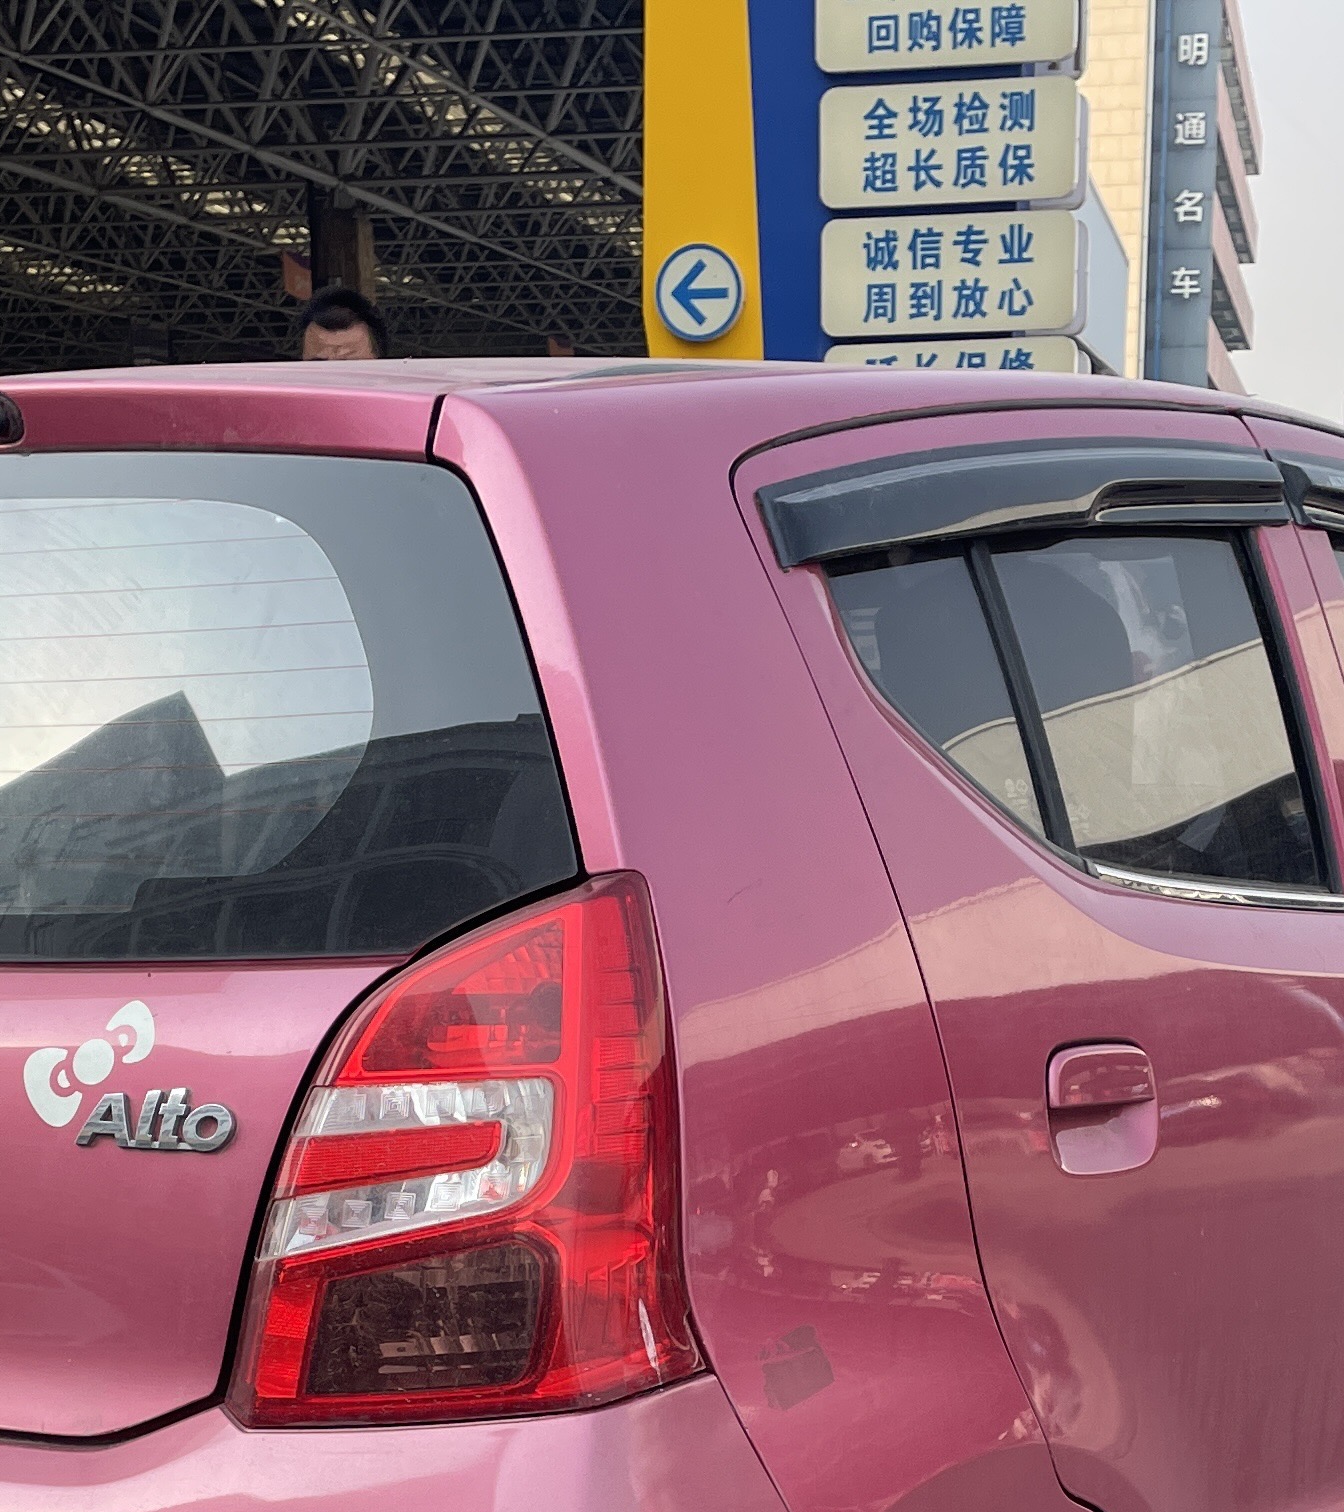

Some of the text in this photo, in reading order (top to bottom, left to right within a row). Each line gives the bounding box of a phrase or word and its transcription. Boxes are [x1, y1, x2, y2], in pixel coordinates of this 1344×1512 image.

[867, 3, 1026, 53] 回购保障
[863, 89, 1035, 140] 全场检测
[863, 143, 1035, 192] 超长质保
[1170, 33, 1209, 299] 明通名车
[863, 223, 1034, 271] 诚信专业
[863, 277, 1034, 323] 周到放心
[75, 1088, 236, 1154] Alto
